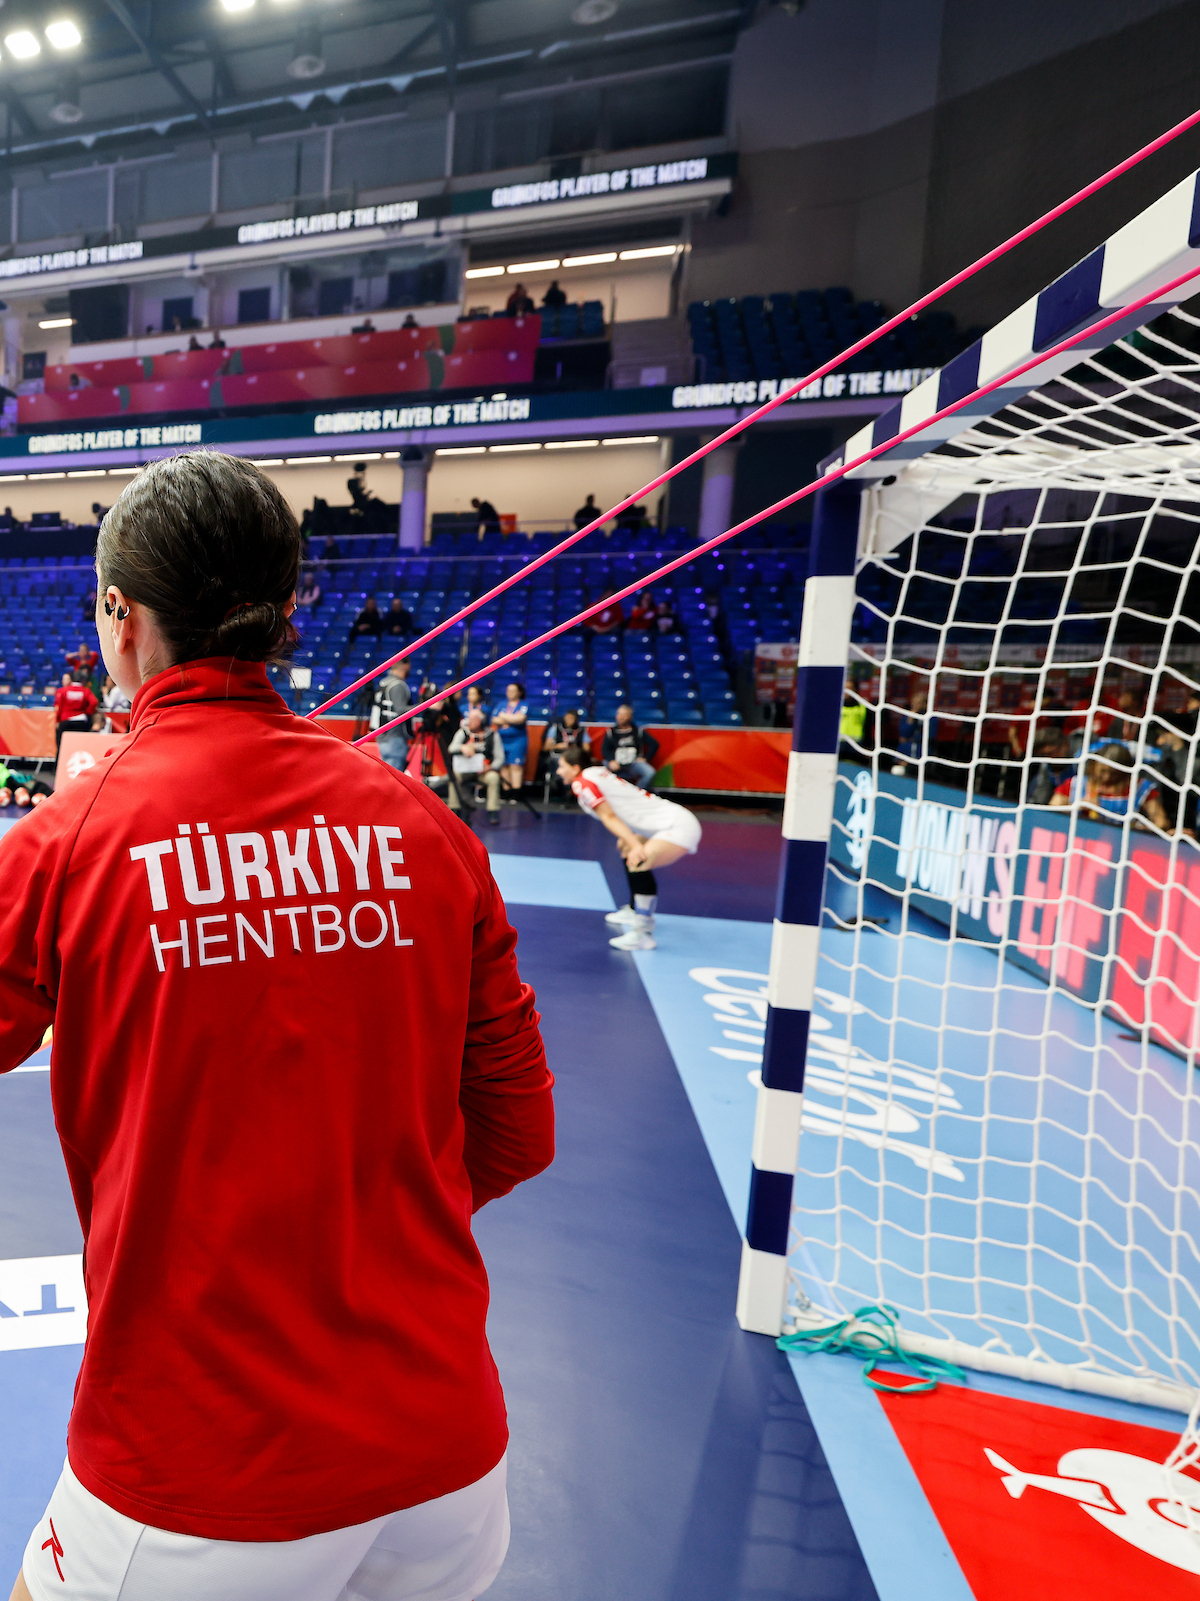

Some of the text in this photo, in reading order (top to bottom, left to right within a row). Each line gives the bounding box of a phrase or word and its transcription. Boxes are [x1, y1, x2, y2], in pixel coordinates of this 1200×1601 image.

[492, 158, 707, 208] GRUNDFOS PLAYER OF THE MATCH
[238, 201, 418, 243] GRUNDFOS PLAYER OF THE MATCH
[41, 250, 76, 272] PLAYER
[76, 249, 89, 267] OF
[90, 246, 108, 265] THE
[108, 241, 143, 263] MATCH
[672, 382, 756, 409] GRUNDFOS
[758, 377, 822, 402] PLAYER
[823, 375, 846, 397] OF
[849, 372, 882, 395] THE
[314, 399, 530, 434] GRUNDFOS PLAYER OF THE MATCH
[29, 424, 201, 454] GRUNDFOS PLAYER OF THE MATCH
[130, 814, 412, 912] TÜRKİYE
[896, 797, 1016, 936] WOMEN'S
[1017, 827, 1112, 989] EHF
[149, 900, 414, 972] HENTBOL
